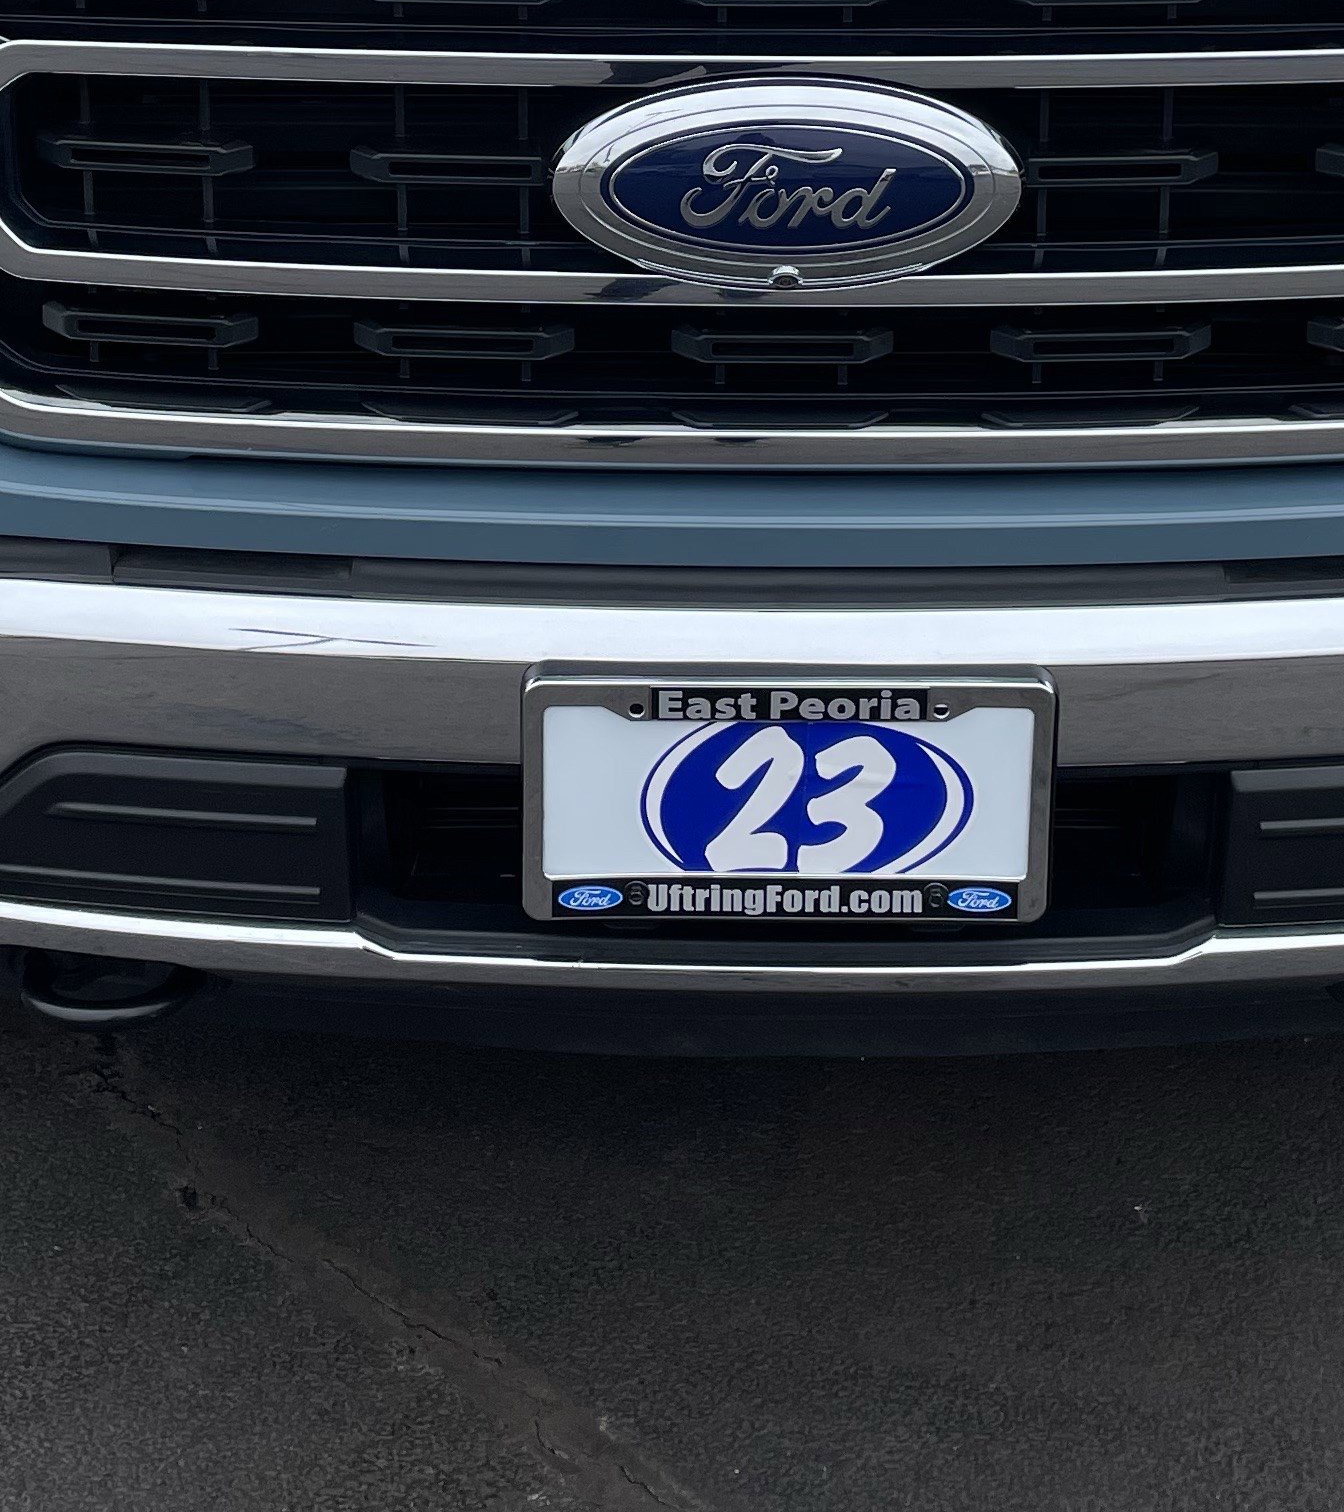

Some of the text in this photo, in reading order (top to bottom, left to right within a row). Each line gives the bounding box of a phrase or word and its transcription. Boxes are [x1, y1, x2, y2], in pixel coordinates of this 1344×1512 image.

[680, 143, 897, 230] Ford
[658, 690, 921, 721] East Peoria
[704, 725, 897, 873] 23
[647, 884, 923, 916] UftringFord.com
